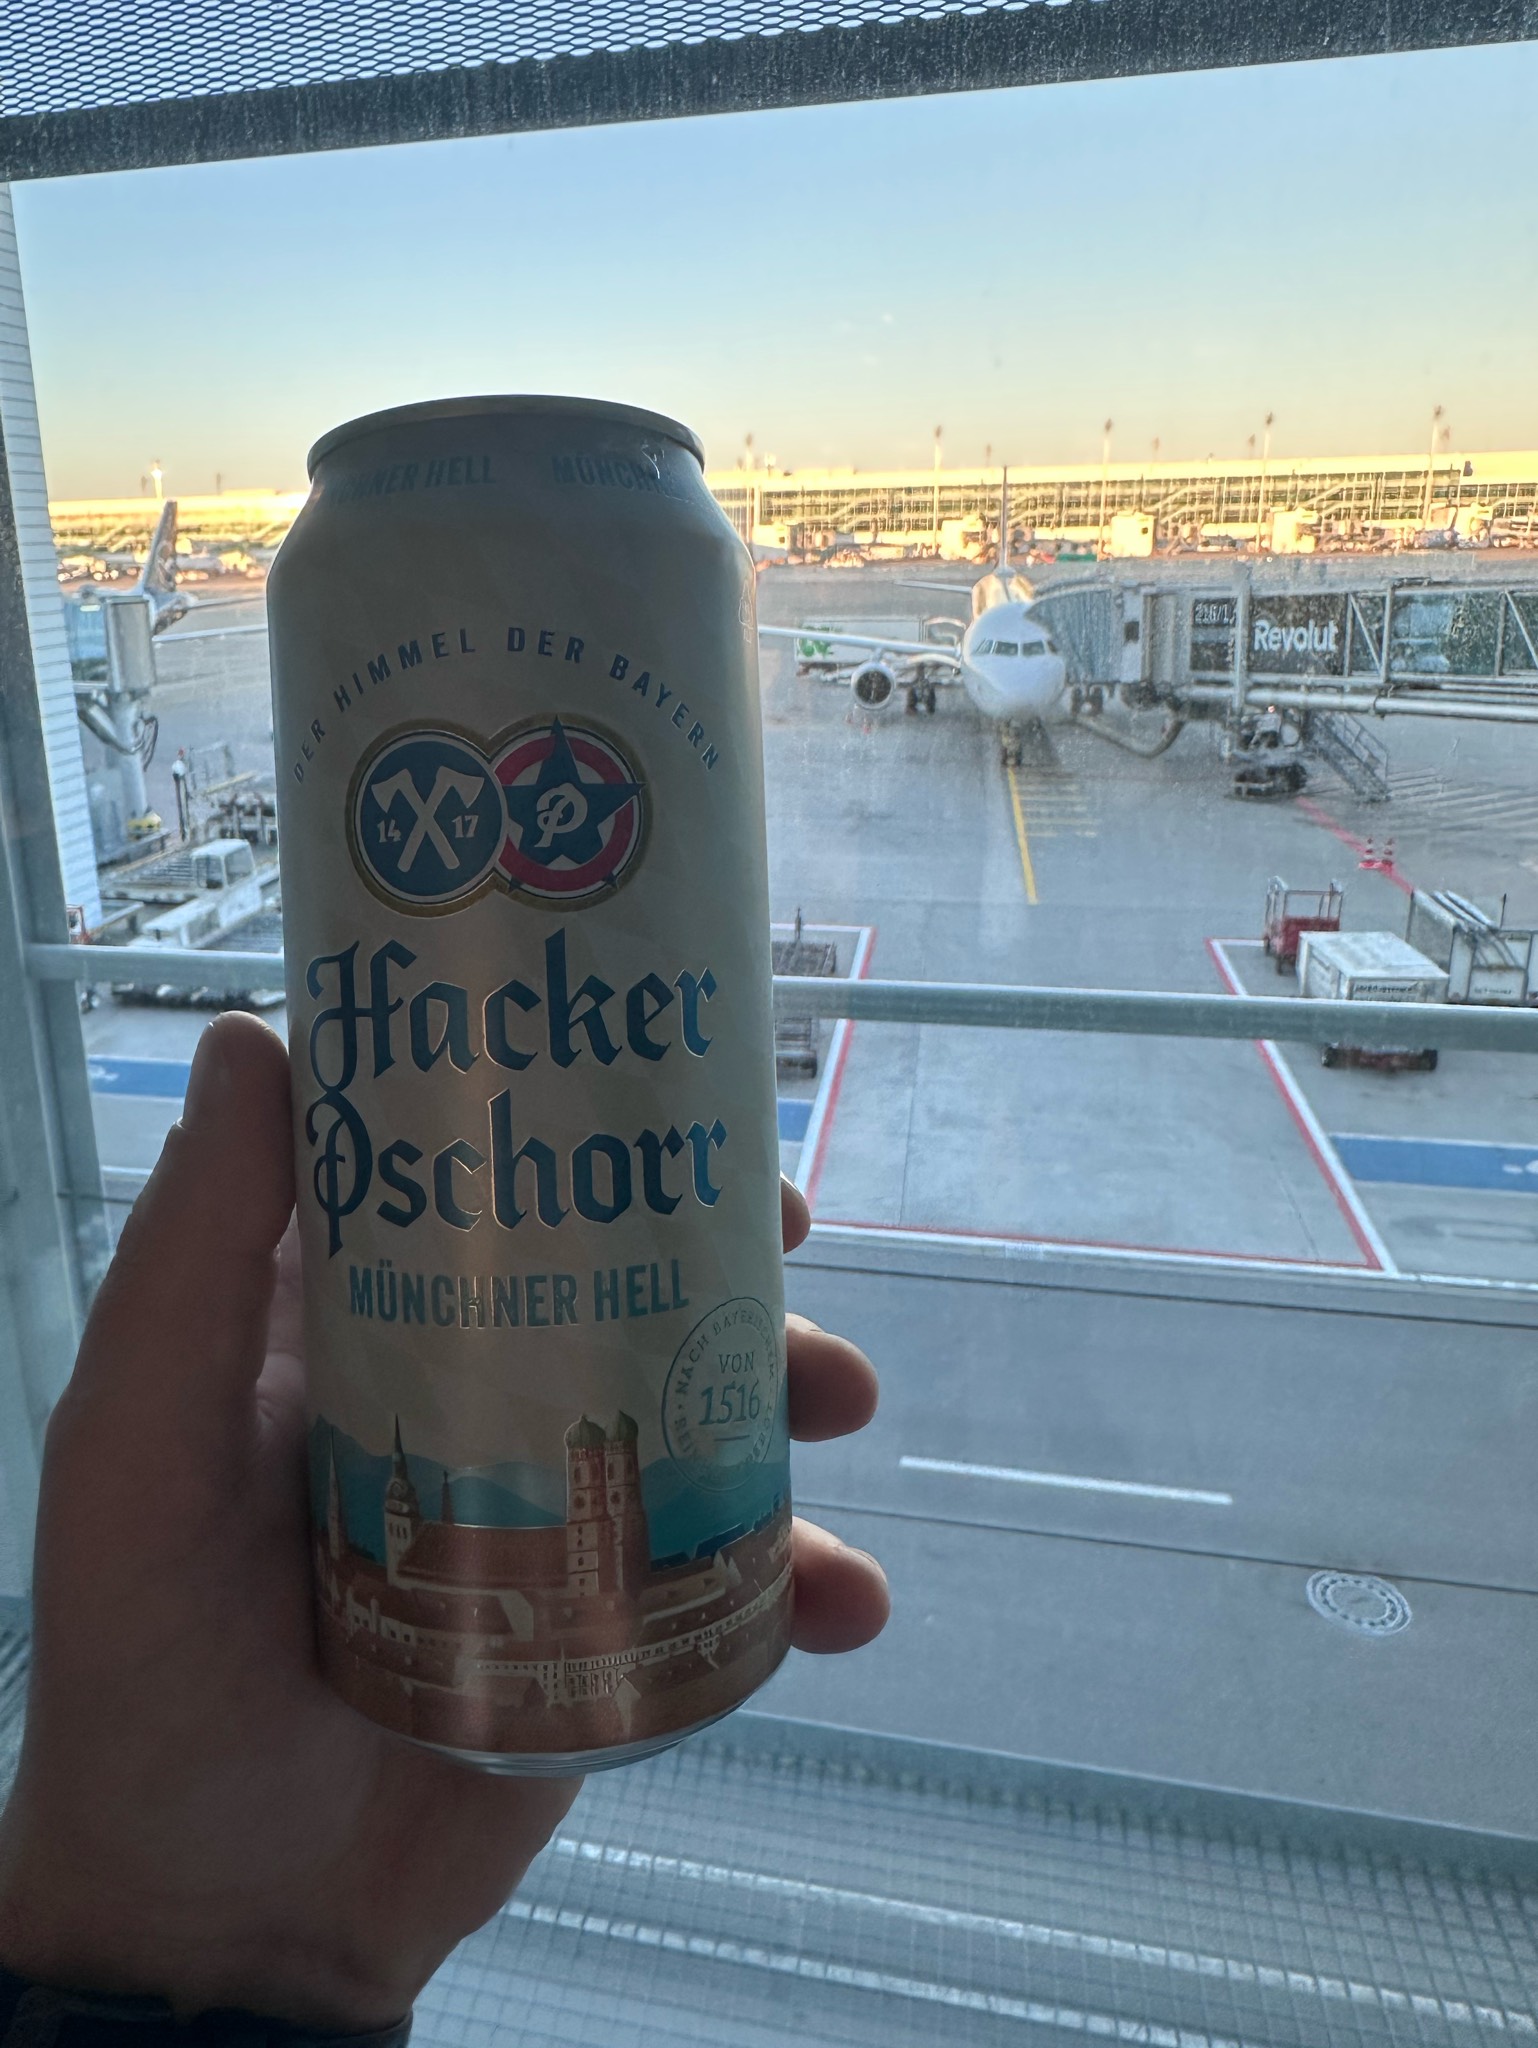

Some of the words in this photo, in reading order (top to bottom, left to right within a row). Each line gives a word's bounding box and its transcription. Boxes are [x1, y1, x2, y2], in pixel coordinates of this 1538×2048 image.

[424, 456, 497, 488] HELL
[1254, 619, 1339, 651] Revolut
[294, 718, 326, 784] DER
[333, 628, 475, 714] HIMMEL
[507, 627, 585, 664] DER
[609, 654, 719, 772] BAYERN
[377, 815, 401, 844] 14
[452, 815, 478, 838] 17
[306, 927, 718, 1088] Hacker
[305, 1088, 727, 1260] Pschorr
[348, 1260, 579, 1330] MÜNCHNER
[593, 1259, 690, 1323] HELL
[675, 1334, 709, 1395] NACH
[718, 1351, 756, 1374] VON
[698, 1376, 761, 1426] 1516
